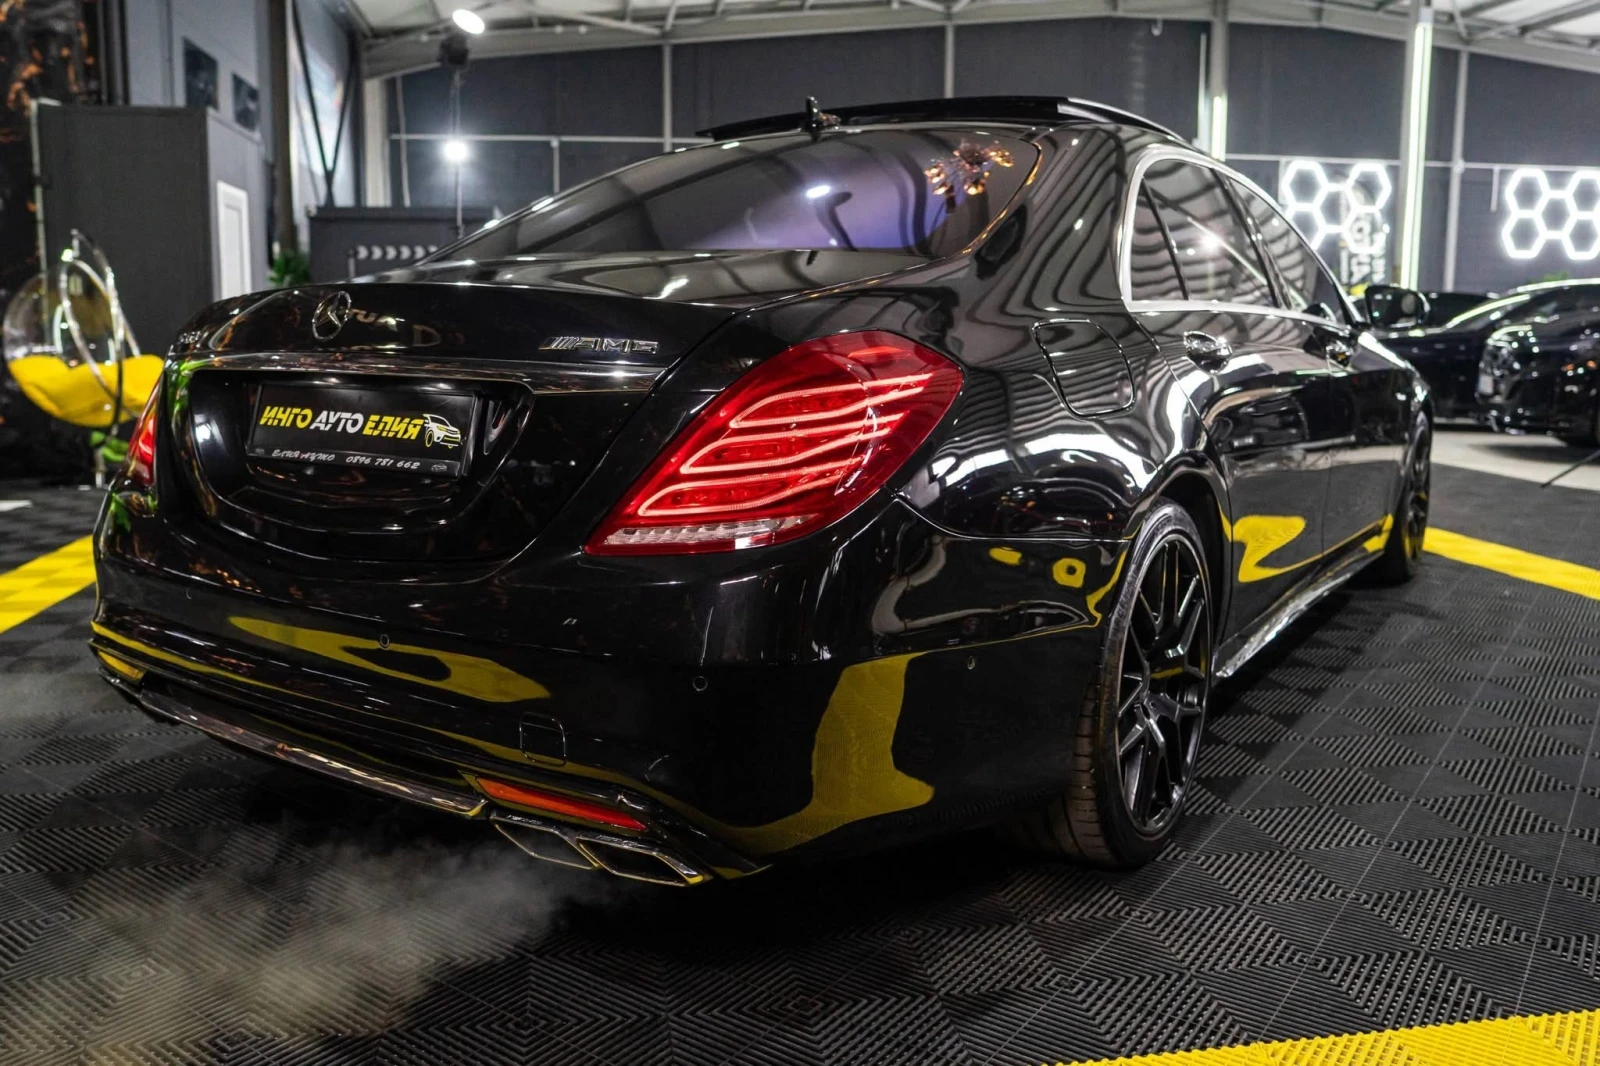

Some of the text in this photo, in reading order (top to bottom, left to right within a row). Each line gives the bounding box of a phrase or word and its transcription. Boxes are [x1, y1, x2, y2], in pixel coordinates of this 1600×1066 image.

[573, 336, 659, 354] AMG
[259, 406, 425, 440] ИНГО АУТО ЕЛИЯ
[345, 456, 372, 464] 0896
[374, 458, 394, 466] 781
[396, 460, 421, 469] 662
